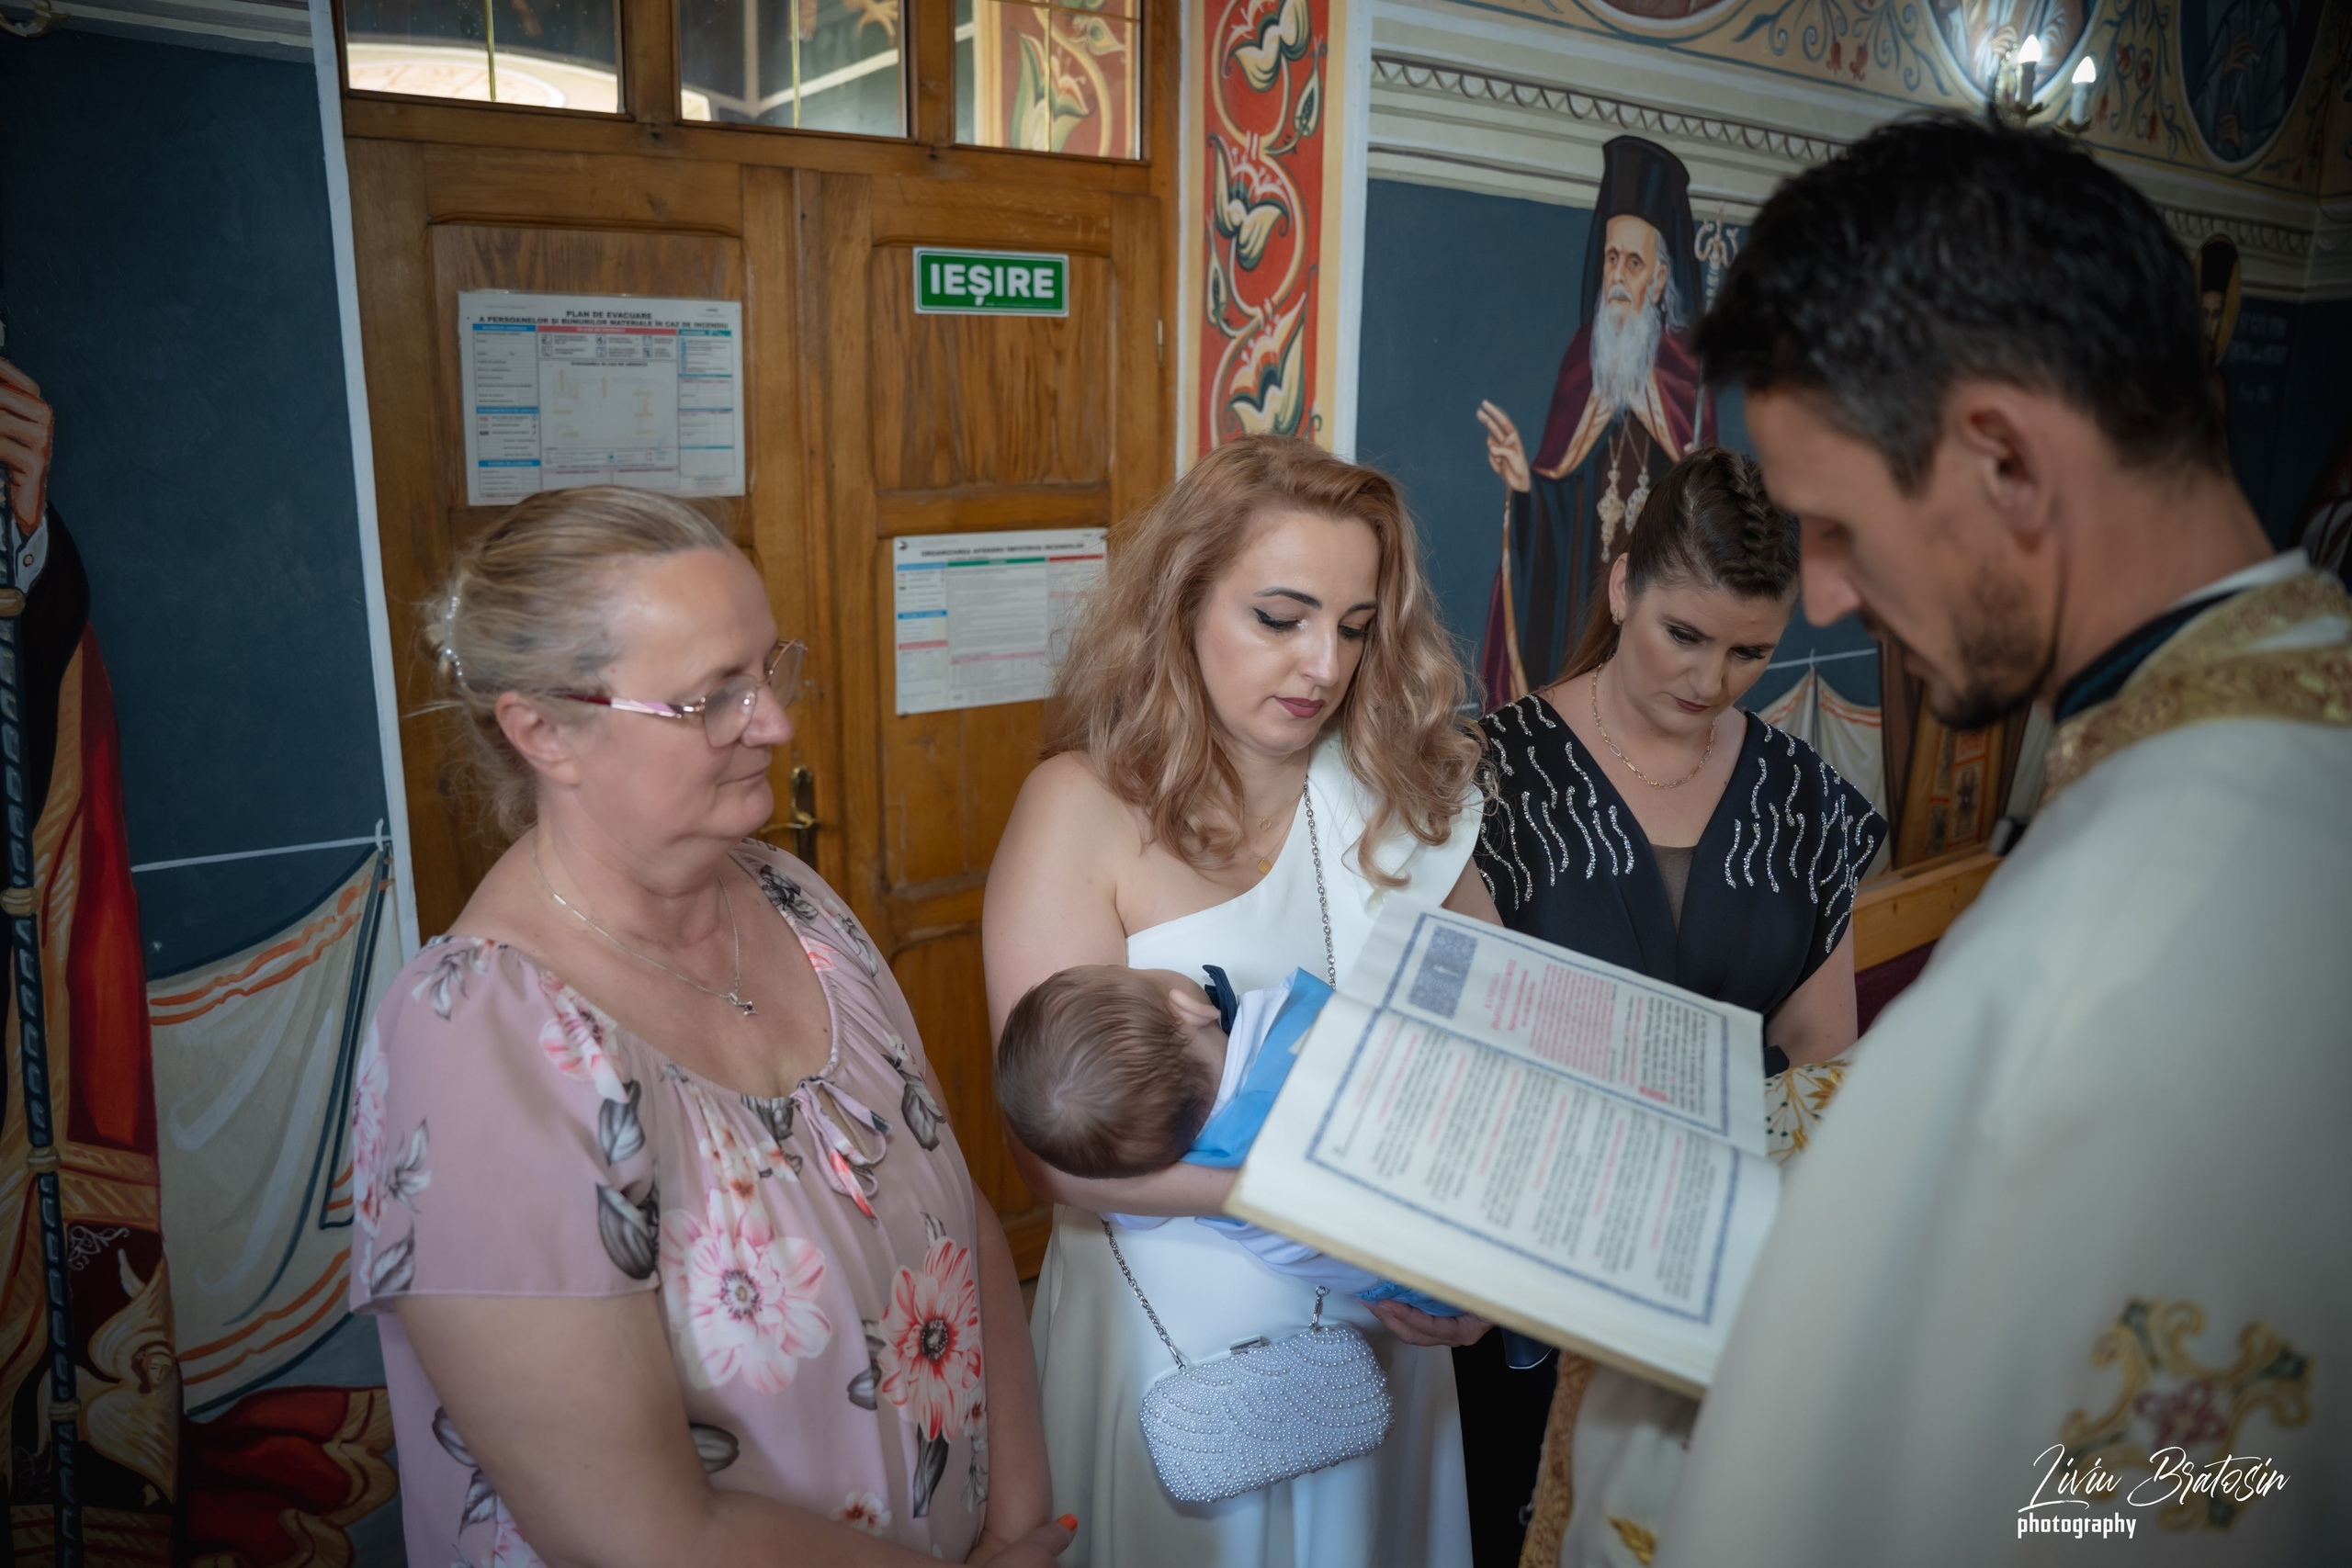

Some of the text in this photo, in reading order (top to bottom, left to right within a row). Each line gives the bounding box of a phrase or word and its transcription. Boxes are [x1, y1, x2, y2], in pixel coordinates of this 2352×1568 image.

[930, 262, 1055, 306] IEȘIRE
[487, 316, 549, 324] PERSOANELOR
[606, 311, 652, 320] EVACUARE
